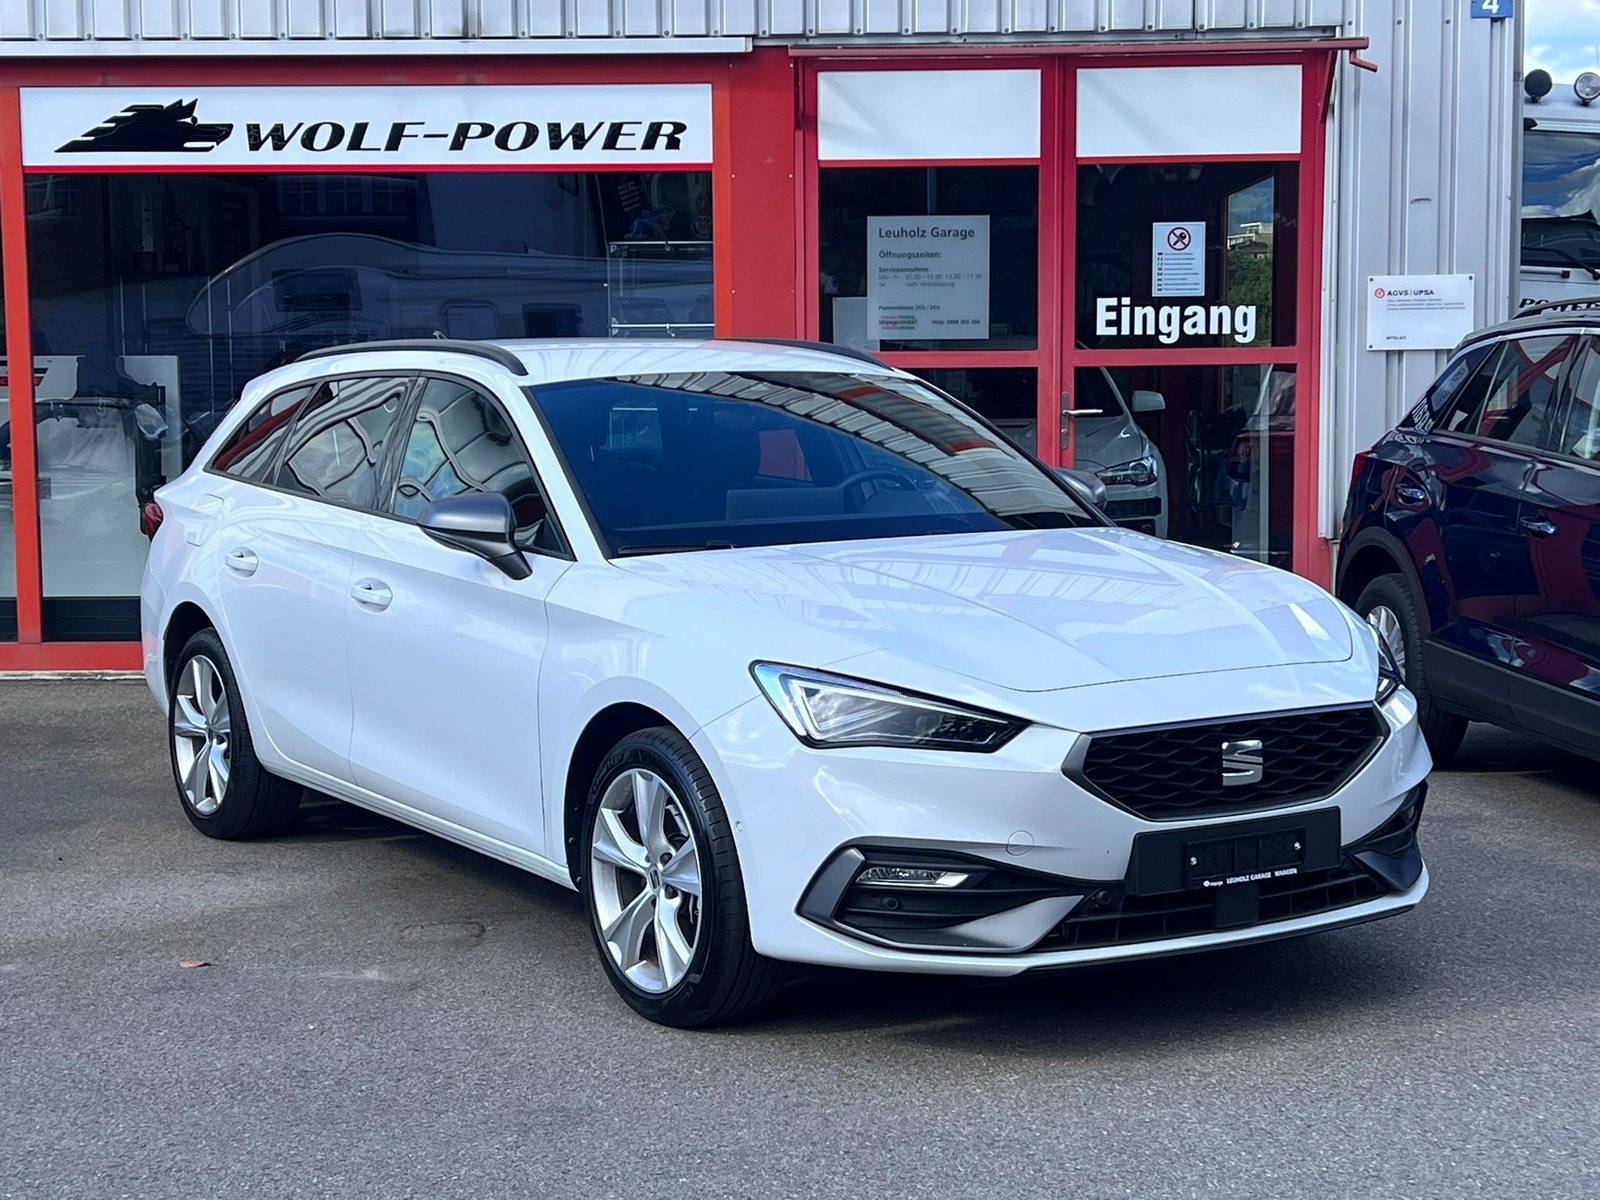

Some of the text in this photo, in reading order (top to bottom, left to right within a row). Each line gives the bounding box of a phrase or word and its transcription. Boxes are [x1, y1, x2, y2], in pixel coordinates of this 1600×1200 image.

[246, 120, 688, 152] WOLF-POWER
[879, 227, 976, 241] Leuholz Garage
[1096, 297, 1257, 345] Eingang
